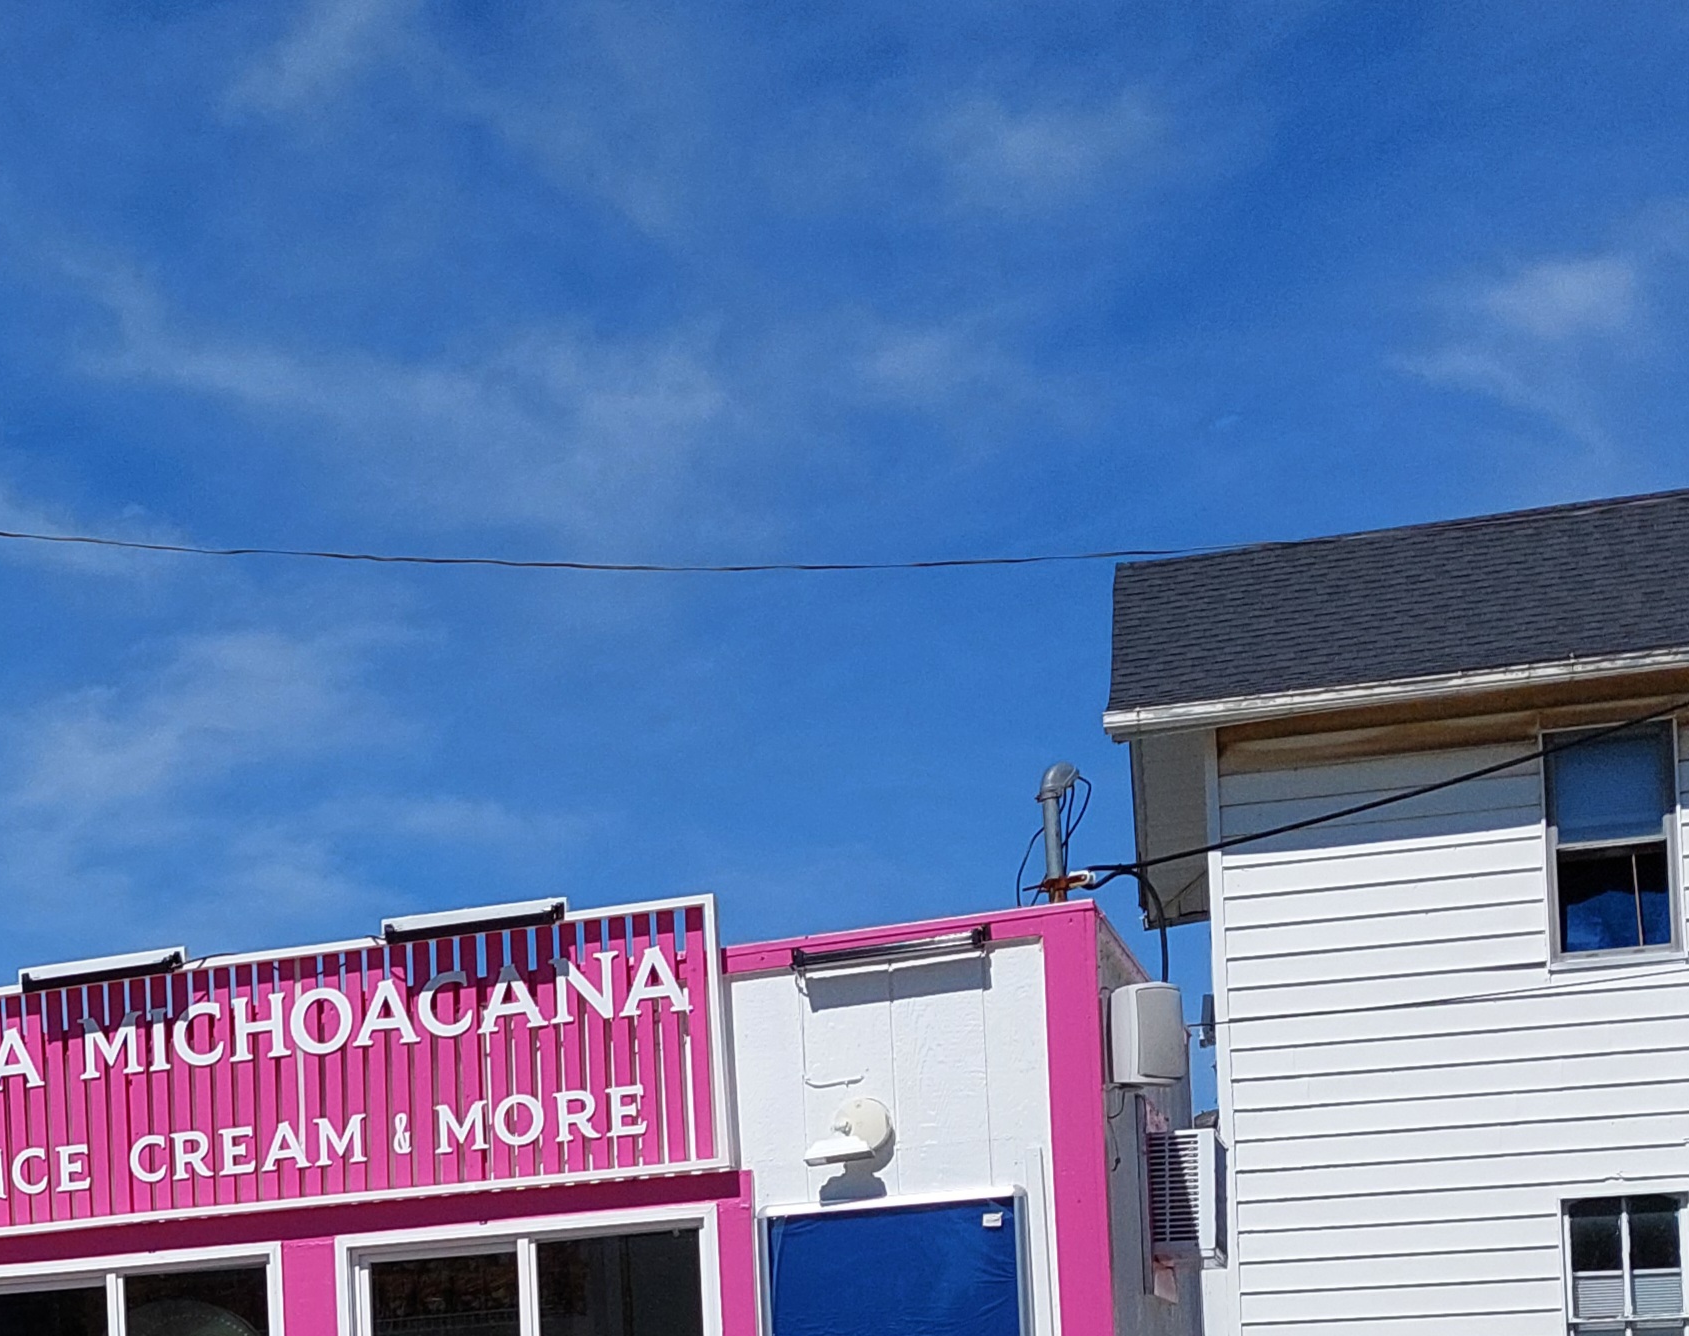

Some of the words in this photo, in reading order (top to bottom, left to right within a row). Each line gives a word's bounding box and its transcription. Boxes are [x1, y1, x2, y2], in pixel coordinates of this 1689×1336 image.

[78, 944, 693, 1081] MICHOACANA
[129, 1113, 368, 1183] CREAM
[393, 1112, 413, 1155] &
[435, 1085, 648, 1154] MORE
